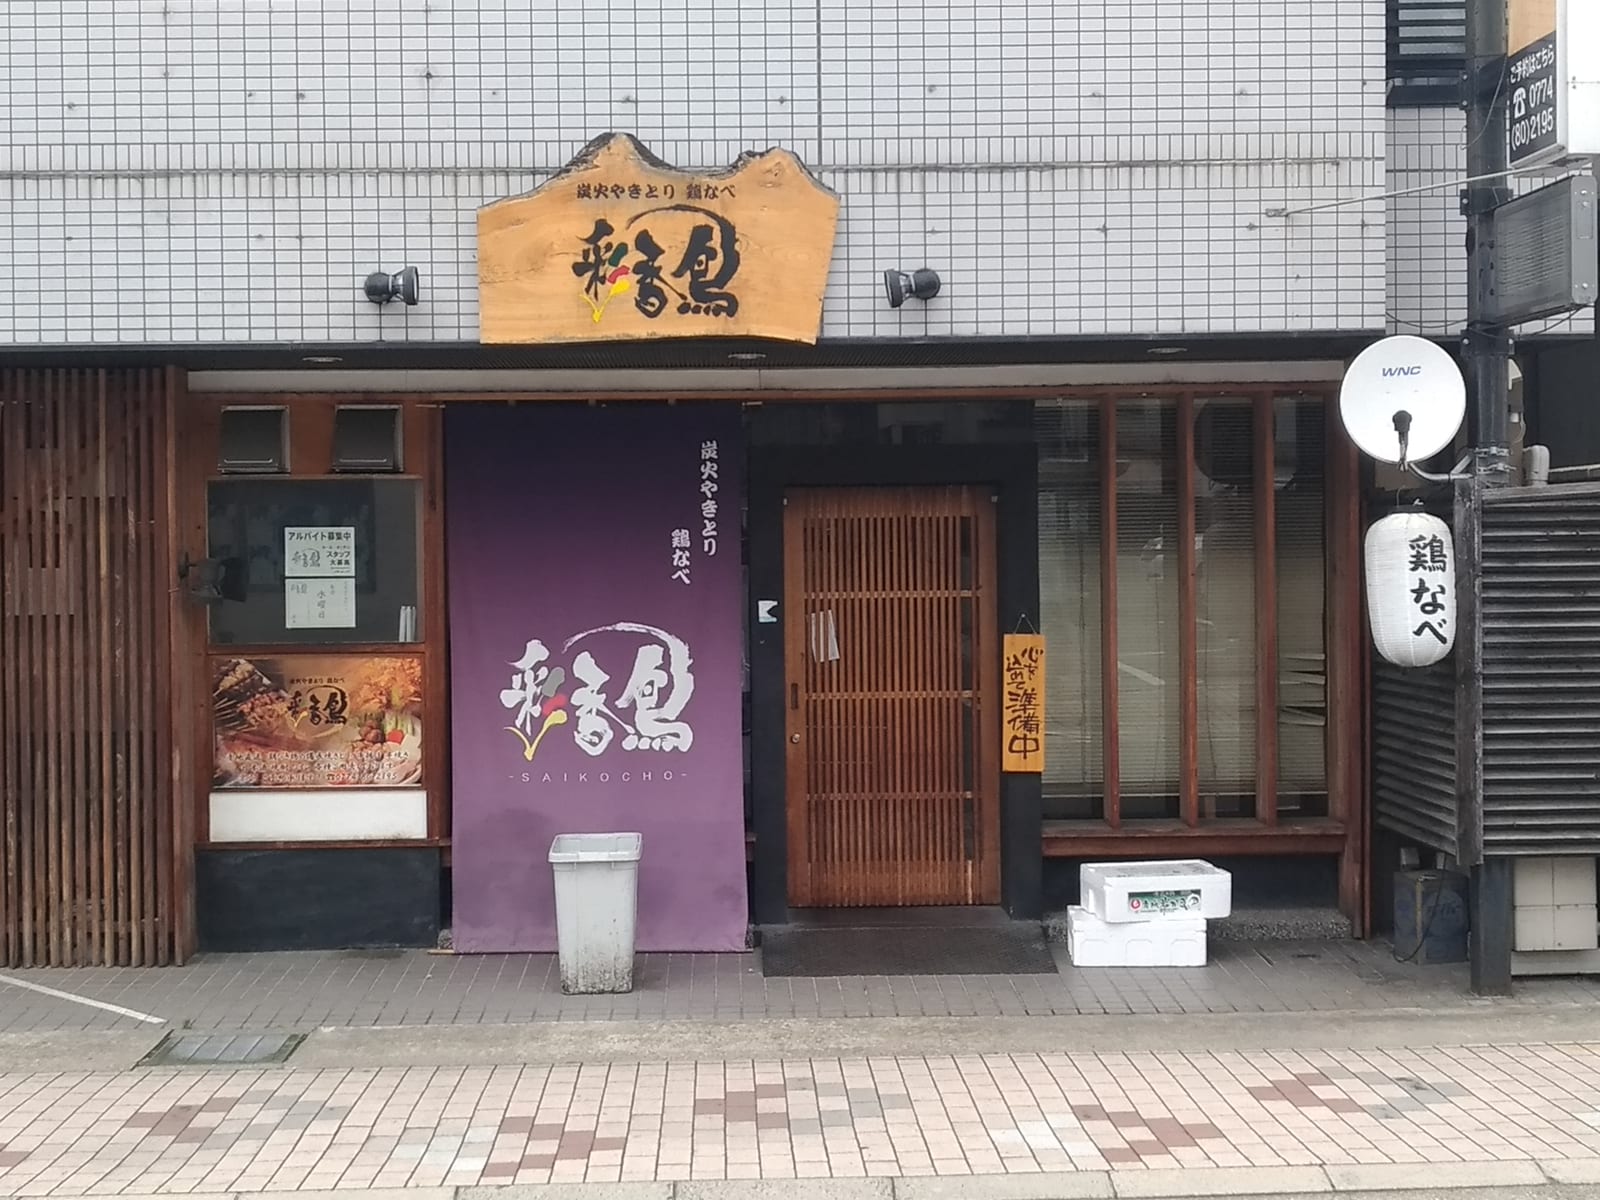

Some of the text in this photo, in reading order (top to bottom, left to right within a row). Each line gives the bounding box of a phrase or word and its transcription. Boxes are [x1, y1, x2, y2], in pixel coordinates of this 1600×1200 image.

[1510, 44, 1555, 84] ご予約はこちら
[1529, 75, 1554, 109] 0774
[1511, 107, 1554, 151] (80)2195
[576, 183, 737, 200] 炭火やきとり 鶏なべ
[1382, 365, 1422, 377] WNC
[700, 439, 719, 557] 炭火やきとり
[670, 528, 692, 585] 鶏なべ
[1408, 533, 1448, 646] 鶏なべ
[1005, 687, 1042, 760] 準備中
